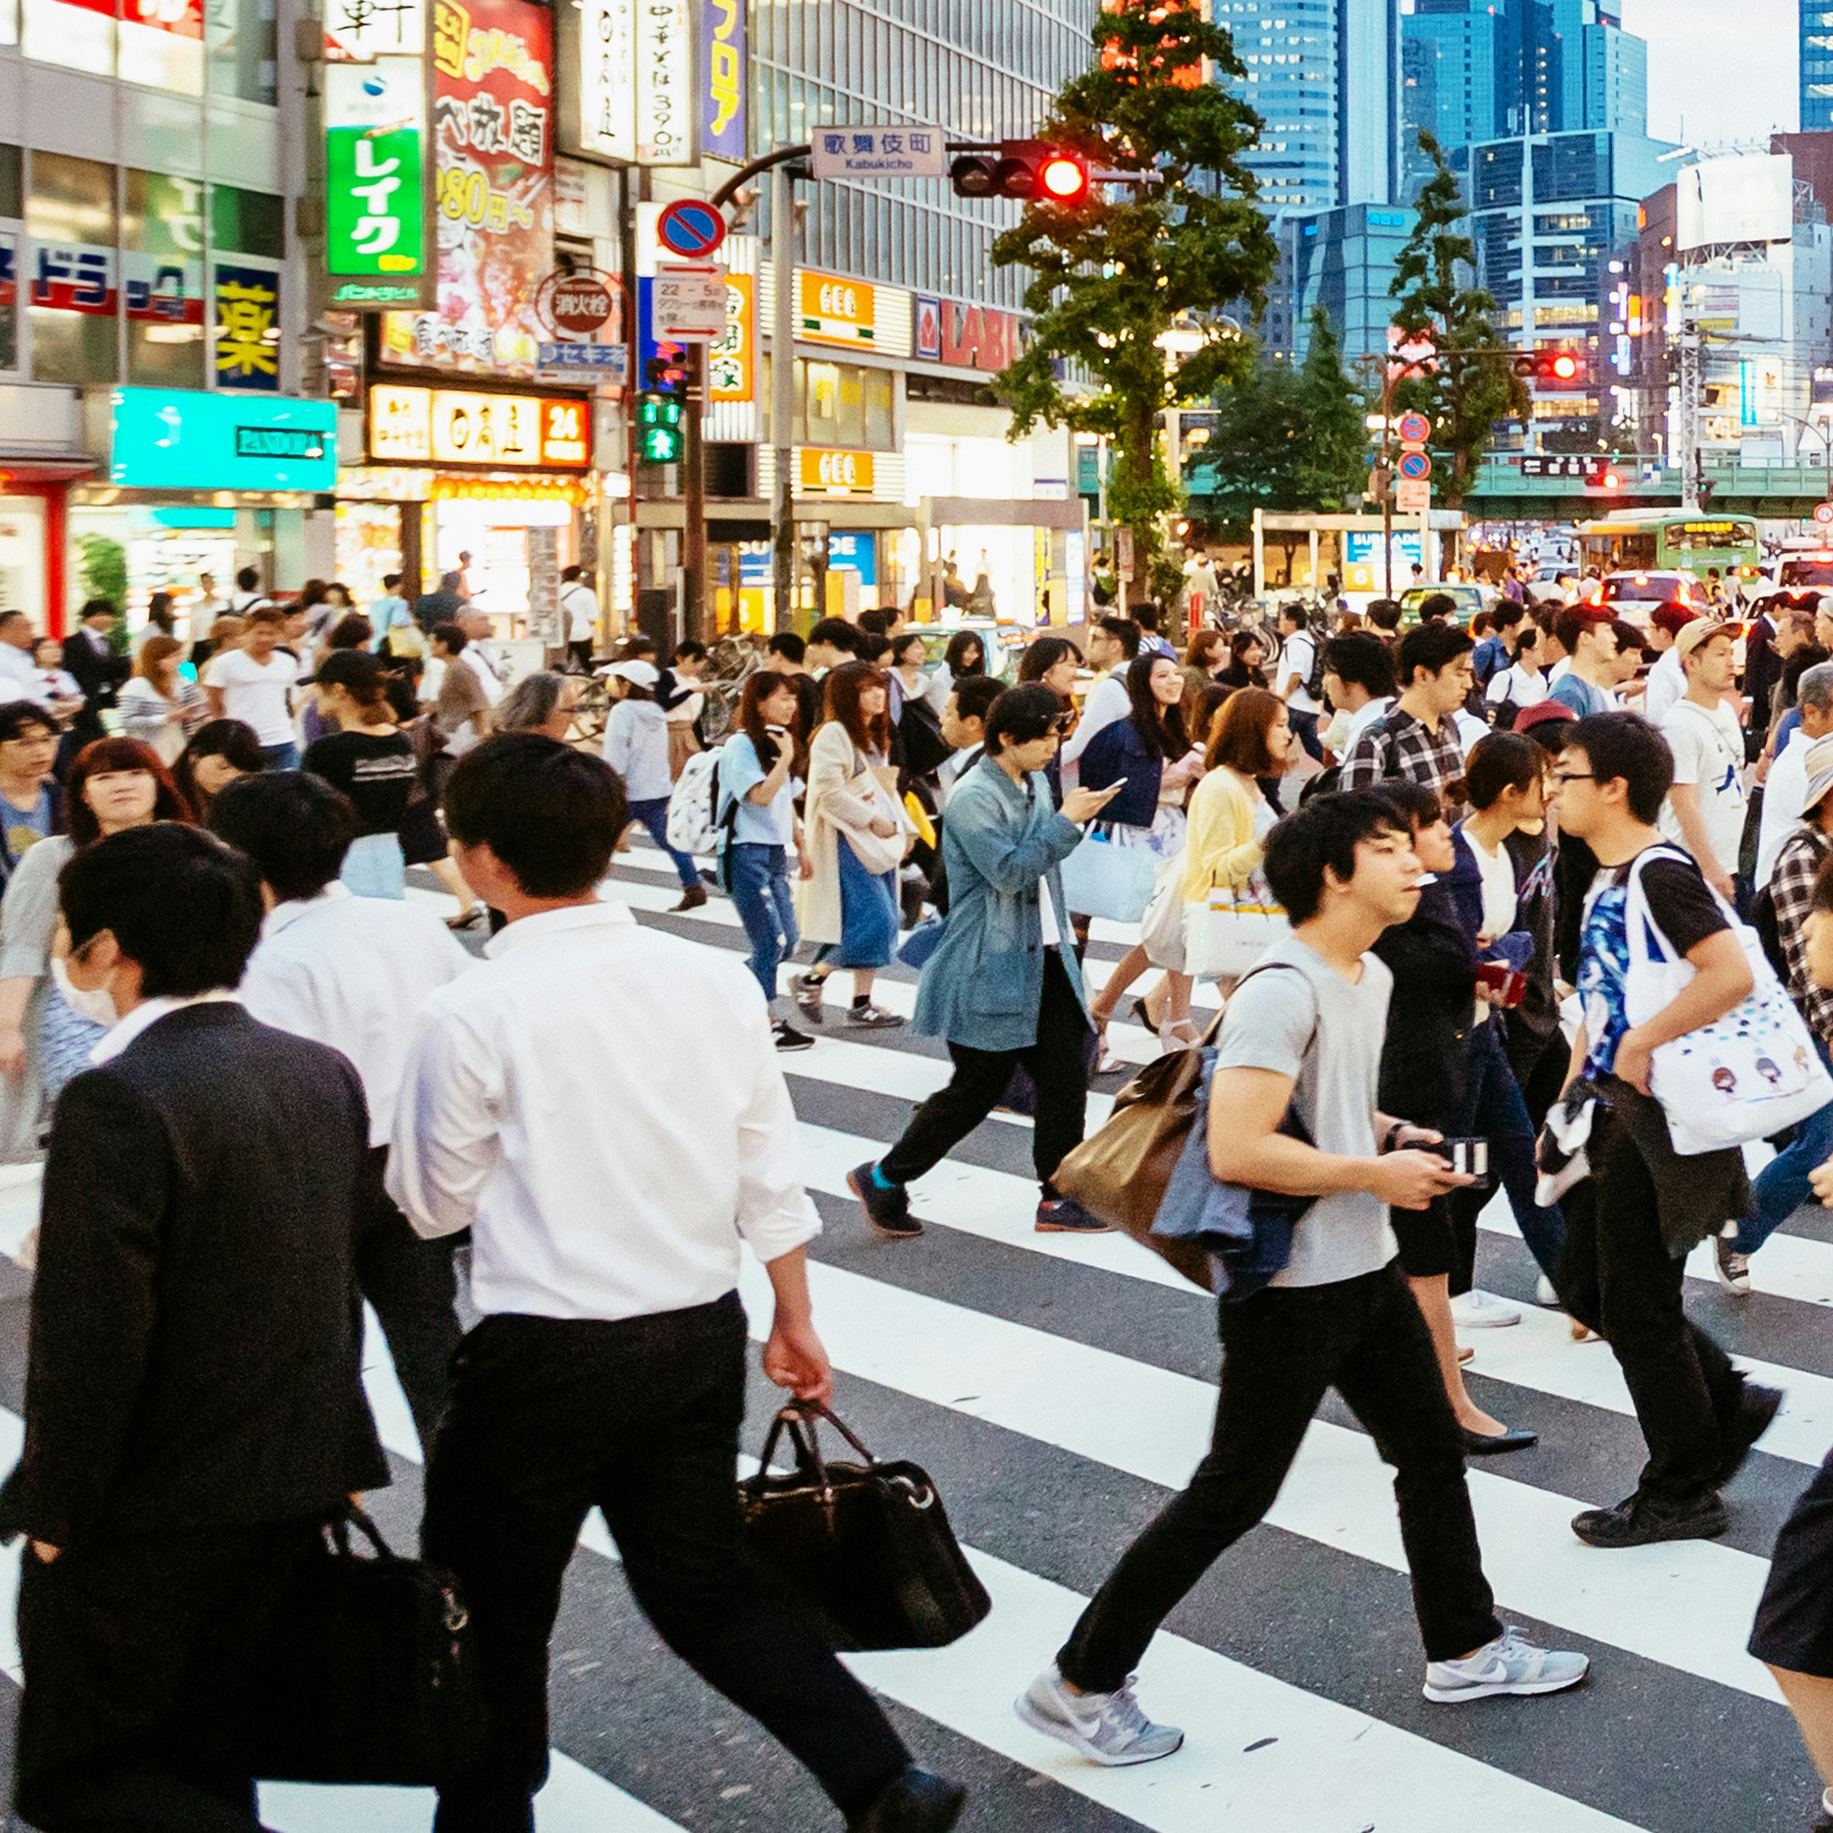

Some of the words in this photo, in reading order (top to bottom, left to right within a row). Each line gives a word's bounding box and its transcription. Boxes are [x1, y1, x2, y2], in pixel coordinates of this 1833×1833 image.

[822, 133, 931, 155] 歌舞伎町
[844, 158, 914, 171] Kabukicho
[350, 138, 401, 256] レイク
[554, 293, 610, 319] 消火栓
[548, 405, 579, 440] 24
